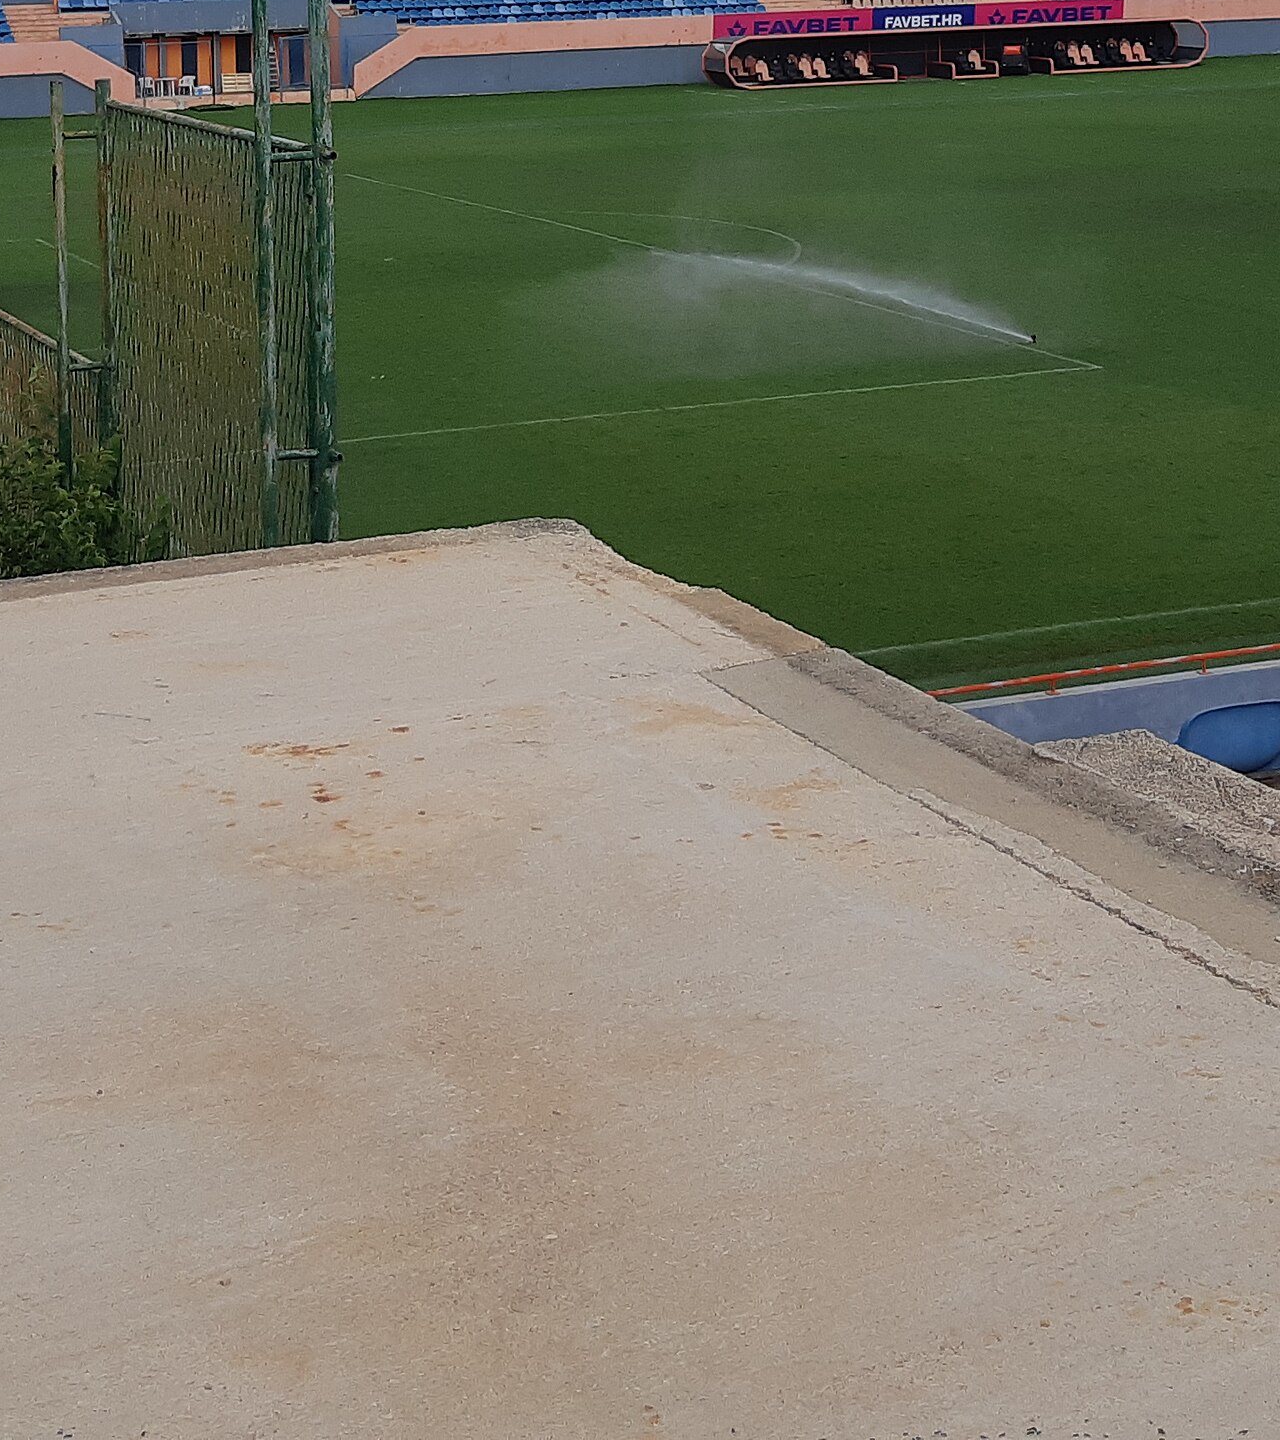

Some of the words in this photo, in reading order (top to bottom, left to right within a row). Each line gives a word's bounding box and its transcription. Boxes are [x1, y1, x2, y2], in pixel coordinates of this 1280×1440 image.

[884, 13, 962, 29] FAVBET.HR
[1012, 6, 1112, 24] FAVBET
[753, 17, 860, 35] FAVBET
